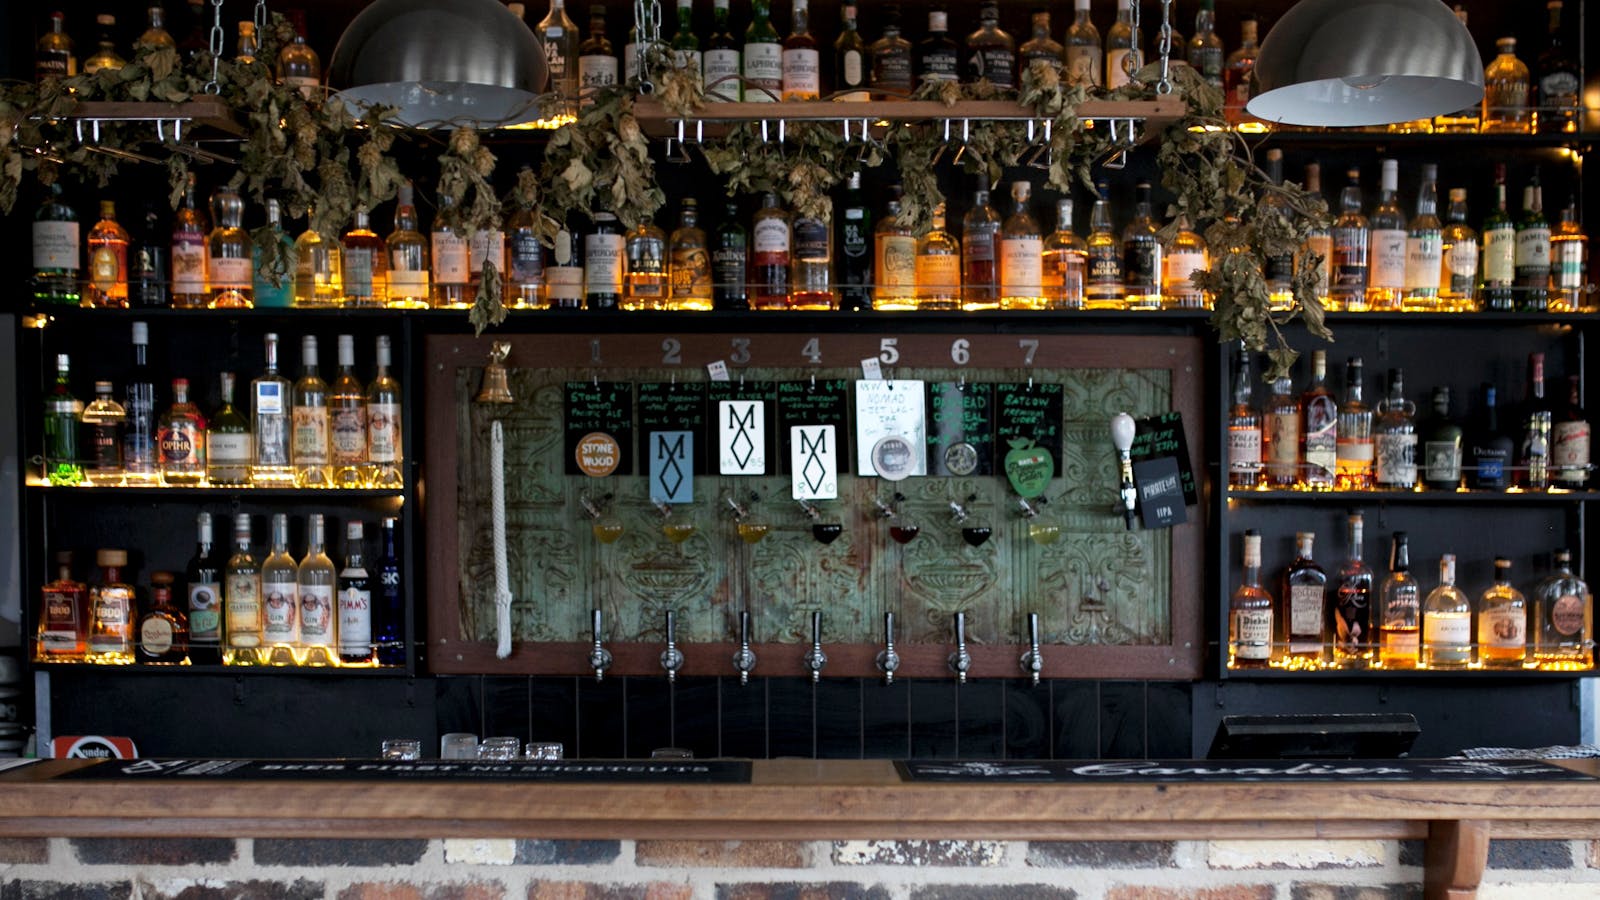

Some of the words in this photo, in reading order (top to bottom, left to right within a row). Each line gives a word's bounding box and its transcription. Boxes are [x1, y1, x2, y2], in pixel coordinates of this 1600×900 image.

[1091, 268, 1121, 276] MORAY
[590, 339, 602, 364] 1
[662, 338, 682, 364] 2
[730, 338, 751, 363] 3
[801, 338, 822, 364] 4
[880, 338, 900, 364] 5
[951, 338, 970, 365] 6
[1019, 339, 1039, 364] 7
[1003, 394, 1050, 406] BATLOW
[162, 440, 191, 451] OPIHR
[581, 443, 614, 455] STONE
[582, 456, 614, 467] WOOD
[1156, 506, 1173, 518] IIPA
[49, 606, 71, 615] 1800
[339, 598, 368, 611] PIMM'S
[96, 606, 121, 618] 1800
[520, 765, 710, 773] SHORTCUTS
